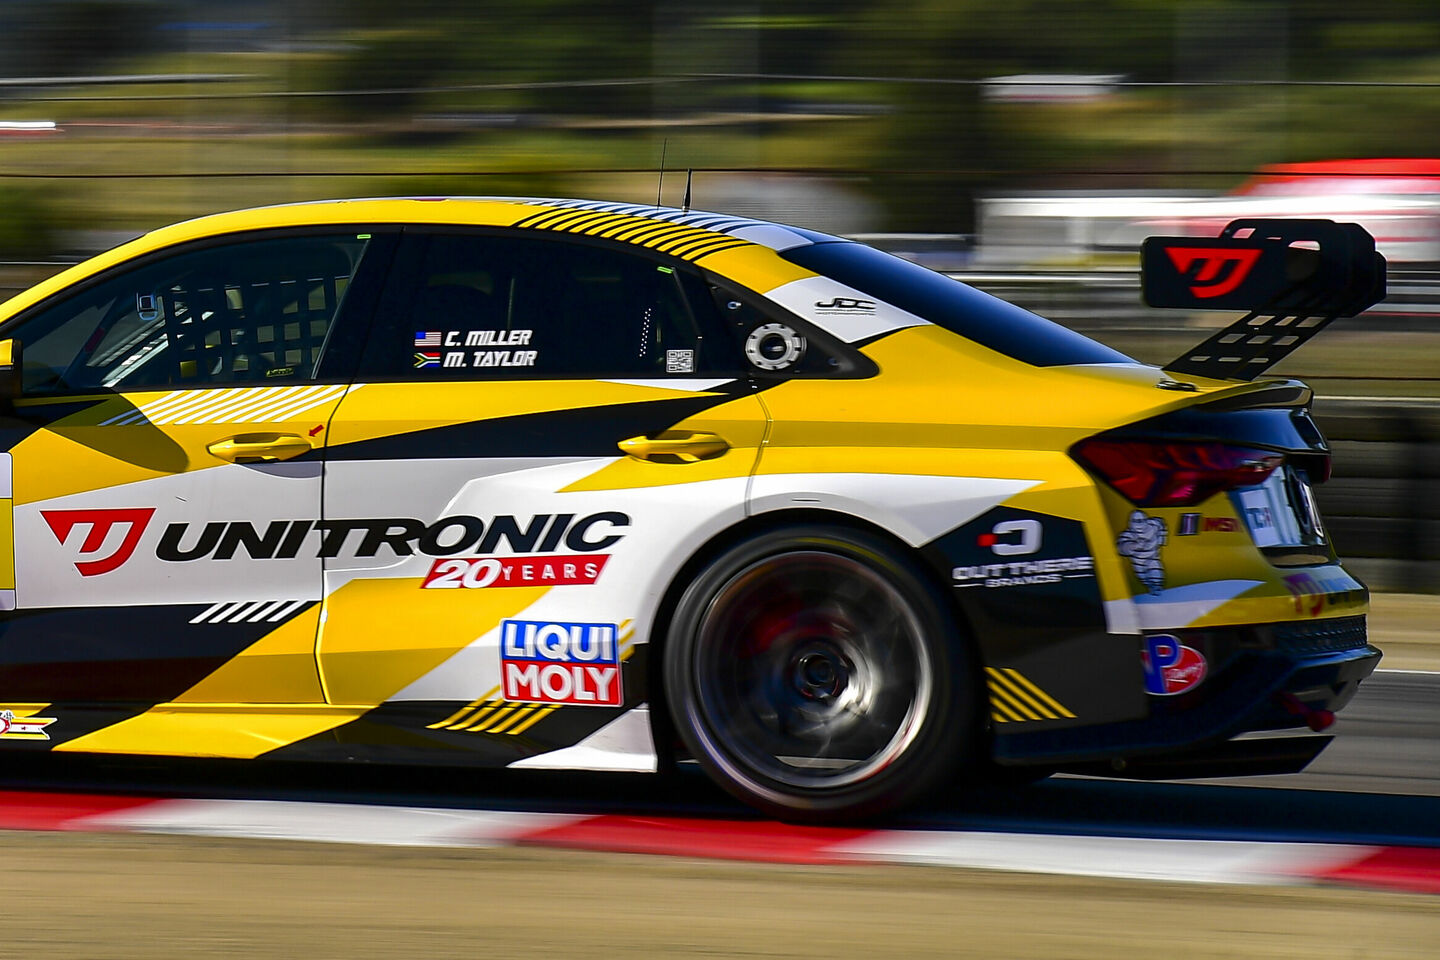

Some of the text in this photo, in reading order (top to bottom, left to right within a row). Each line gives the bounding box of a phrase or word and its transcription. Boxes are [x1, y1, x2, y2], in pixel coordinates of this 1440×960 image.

[444, 330, 533, 347] C. MILLER
[442, 351, 538, 368] M. TAYLOR
[155, 511, 631, 562] UNITRONIC
[425, 559, 599, 589] 20 YEARS
[504, 622, 614, 662] LIQUI
[505, 662, 618, 702] MOLY
